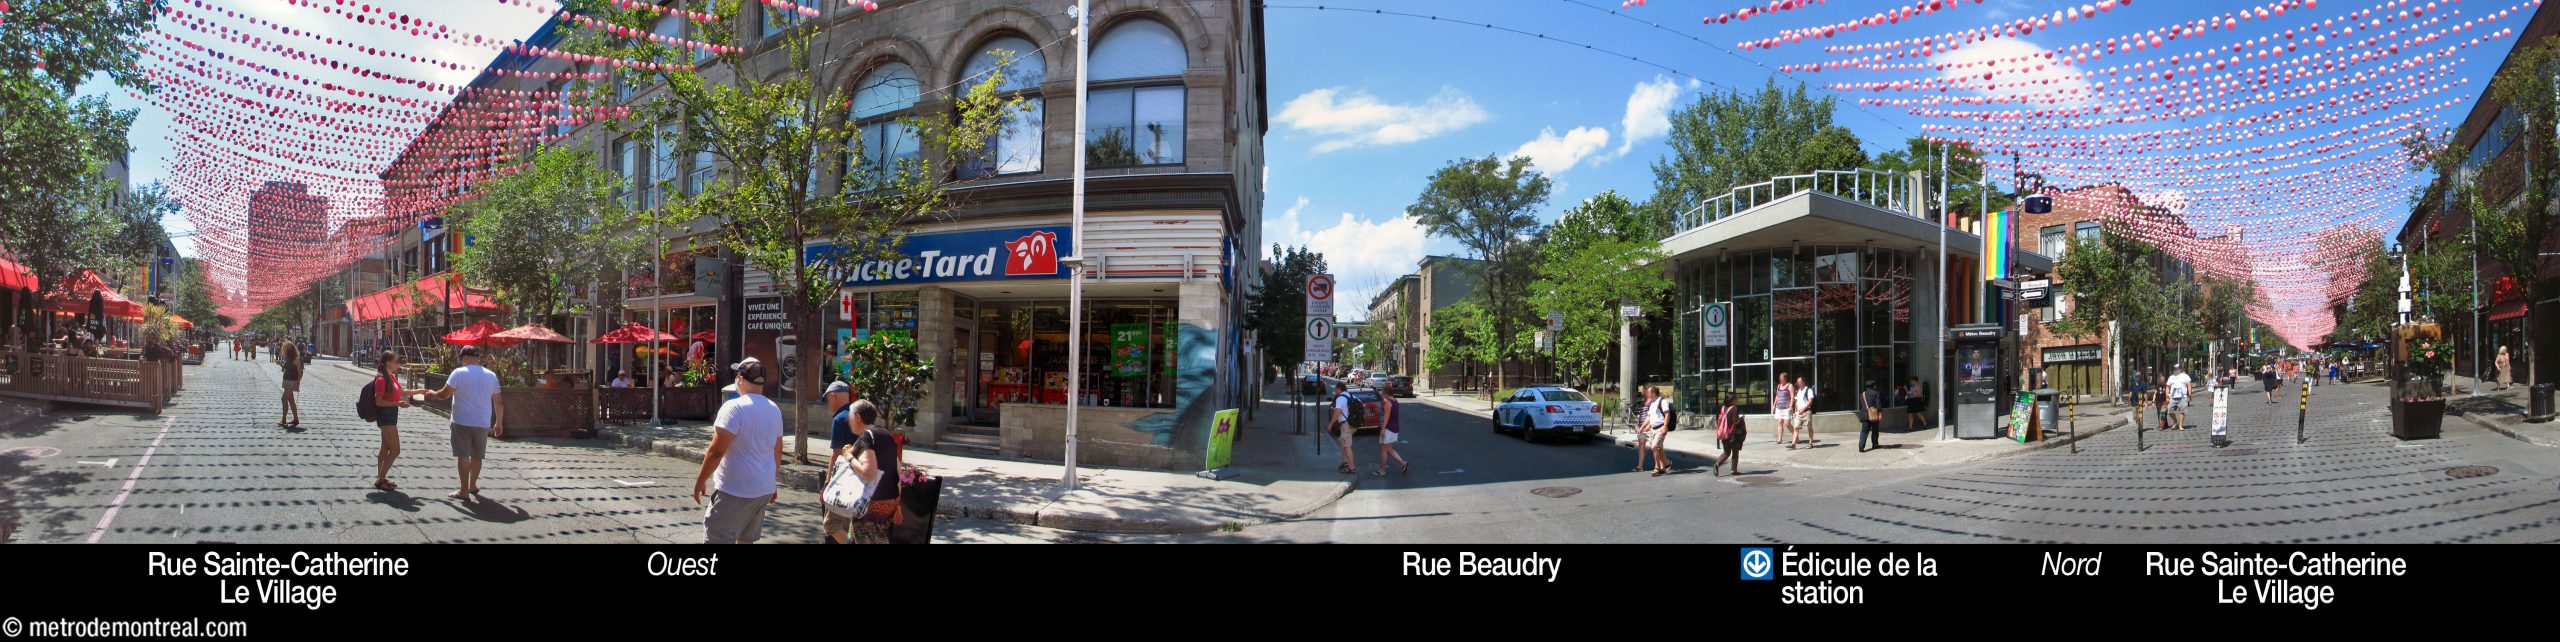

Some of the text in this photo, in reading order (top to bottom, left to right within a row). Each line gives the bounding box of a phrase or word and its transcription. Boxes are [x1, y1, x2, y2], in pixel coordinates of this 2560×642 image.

[748, 303, 780, 312] VIVEZ UNE
[747, 311, 788, 321] EXPÉRIENCE
[747, 322, 794, 330] CAFÉ UNIQUE.
